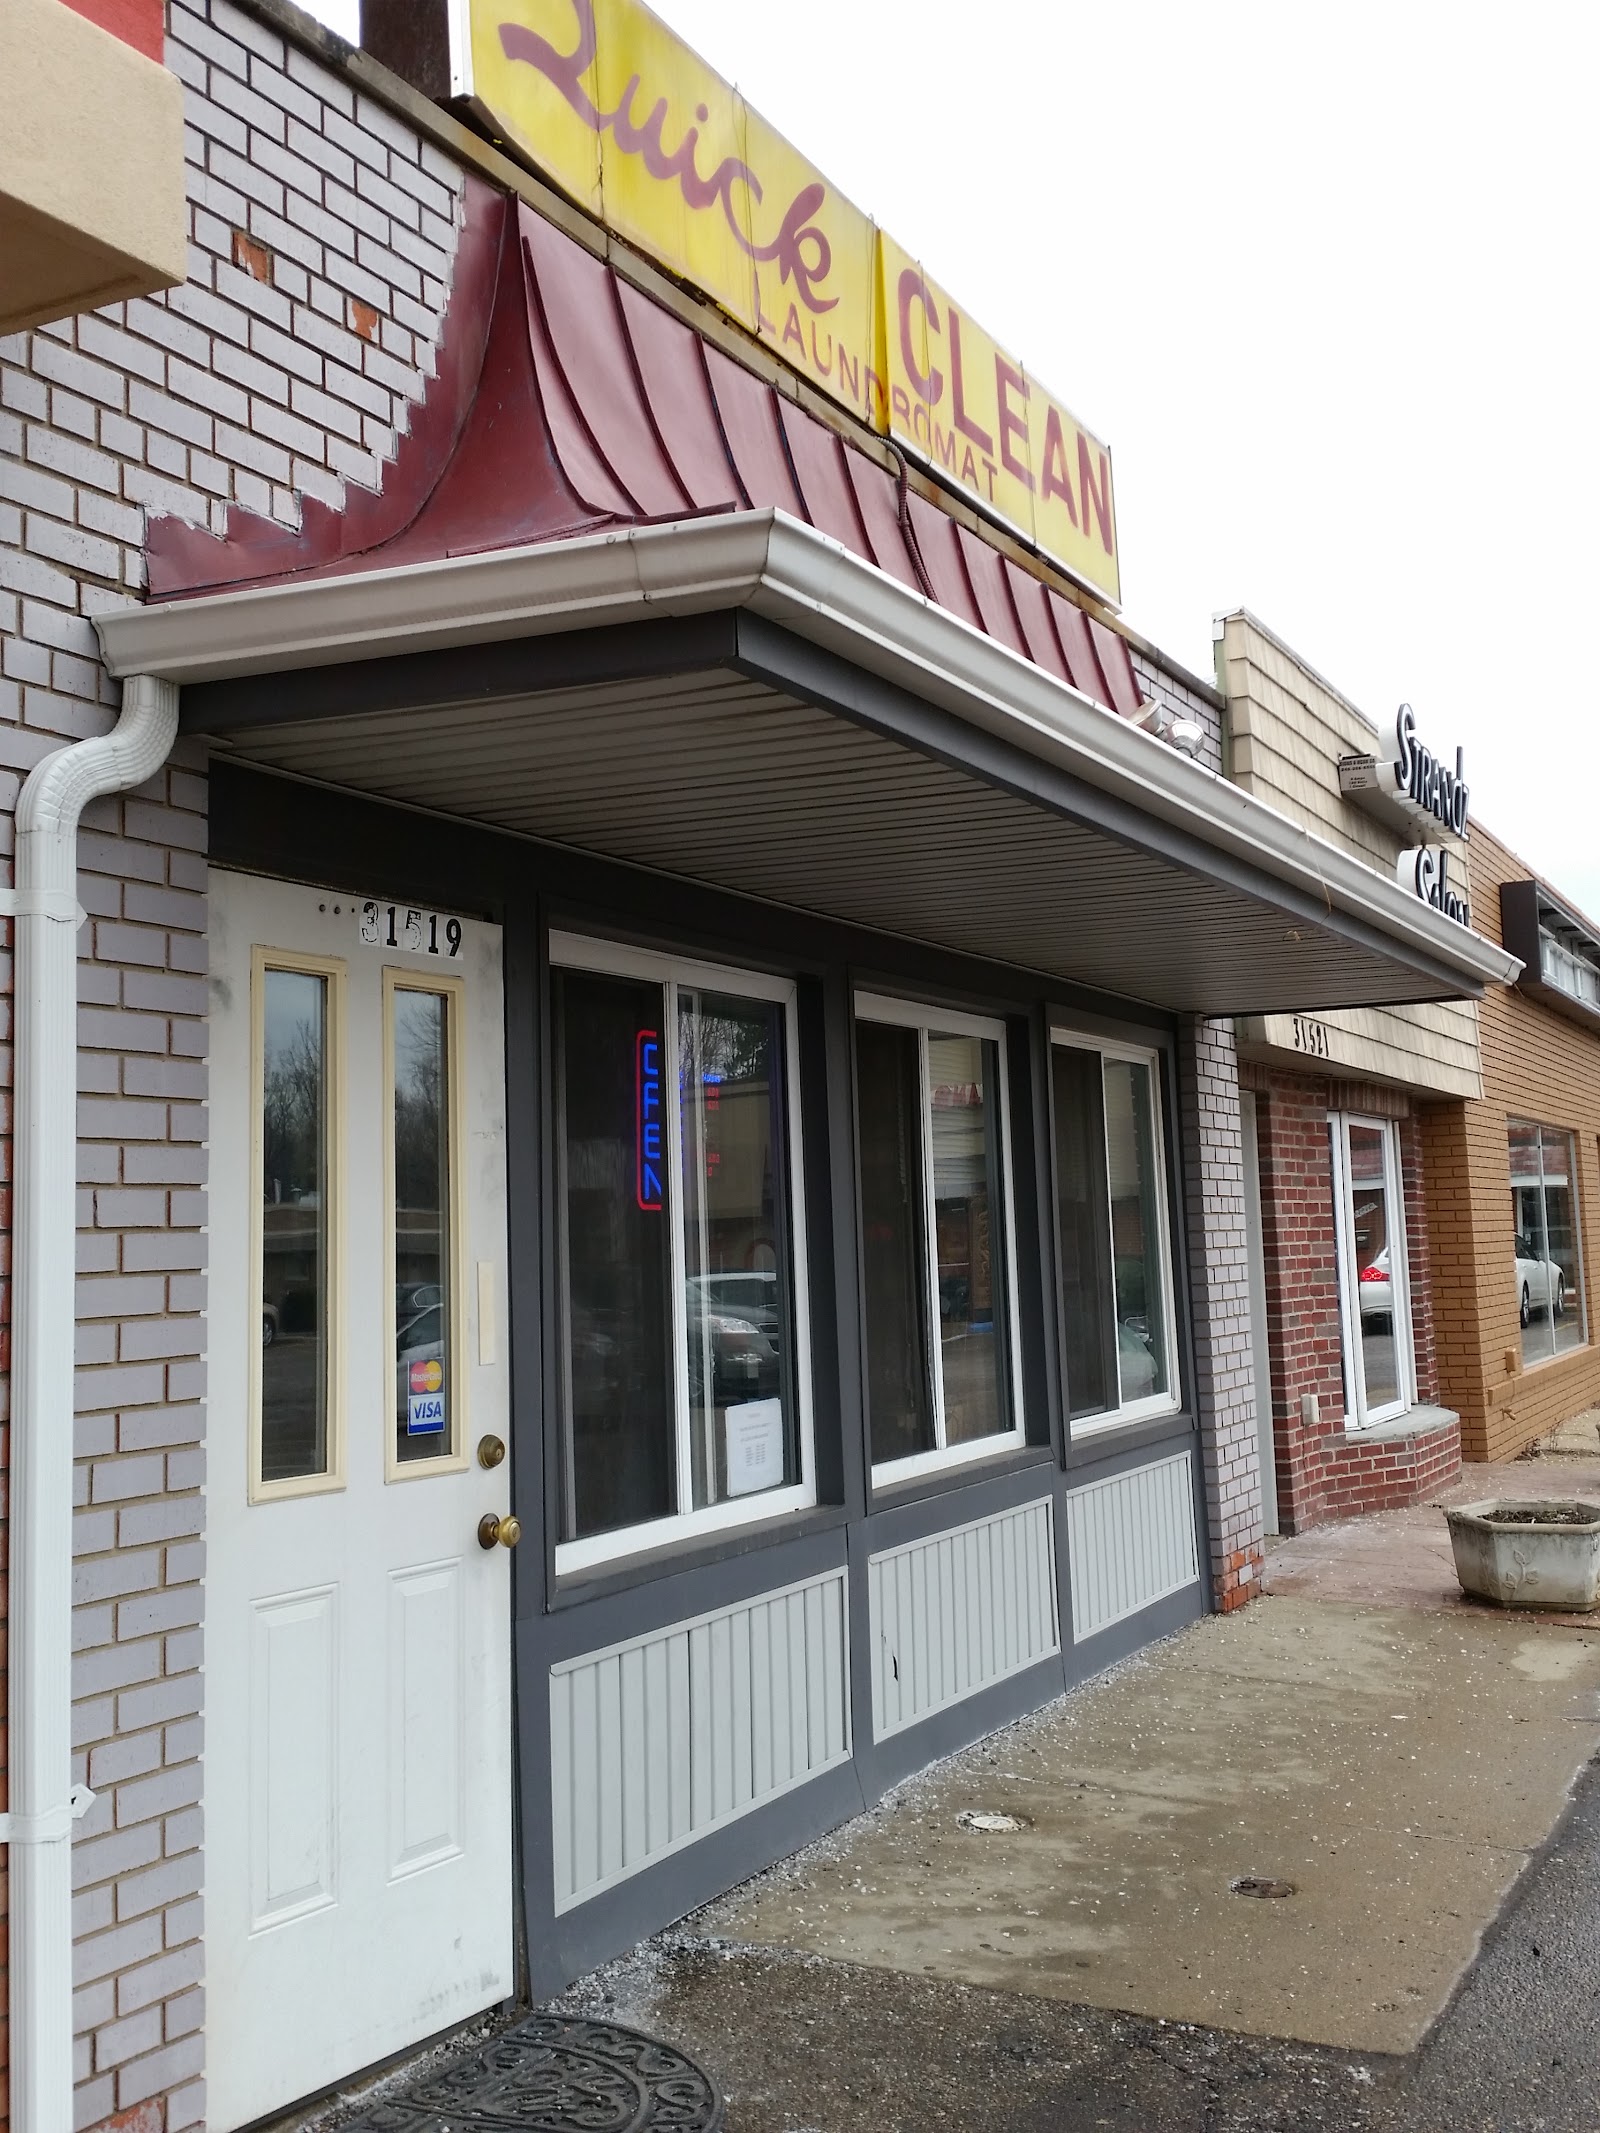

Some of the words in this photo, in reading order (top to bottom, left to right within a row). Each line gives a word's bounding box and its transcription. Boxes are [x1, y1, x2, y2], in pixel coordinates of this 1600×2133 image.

[498, 0, 840, 314] Quick
[897, 266, 1113, 557] CLEAN
[753, 268, 998, 502] LAUNDROMAT
[361, 901, 462, 957] 31519
[1293, 1017, 1330, 1057] 31521
[414, 1401, 442, 1419] VISA
